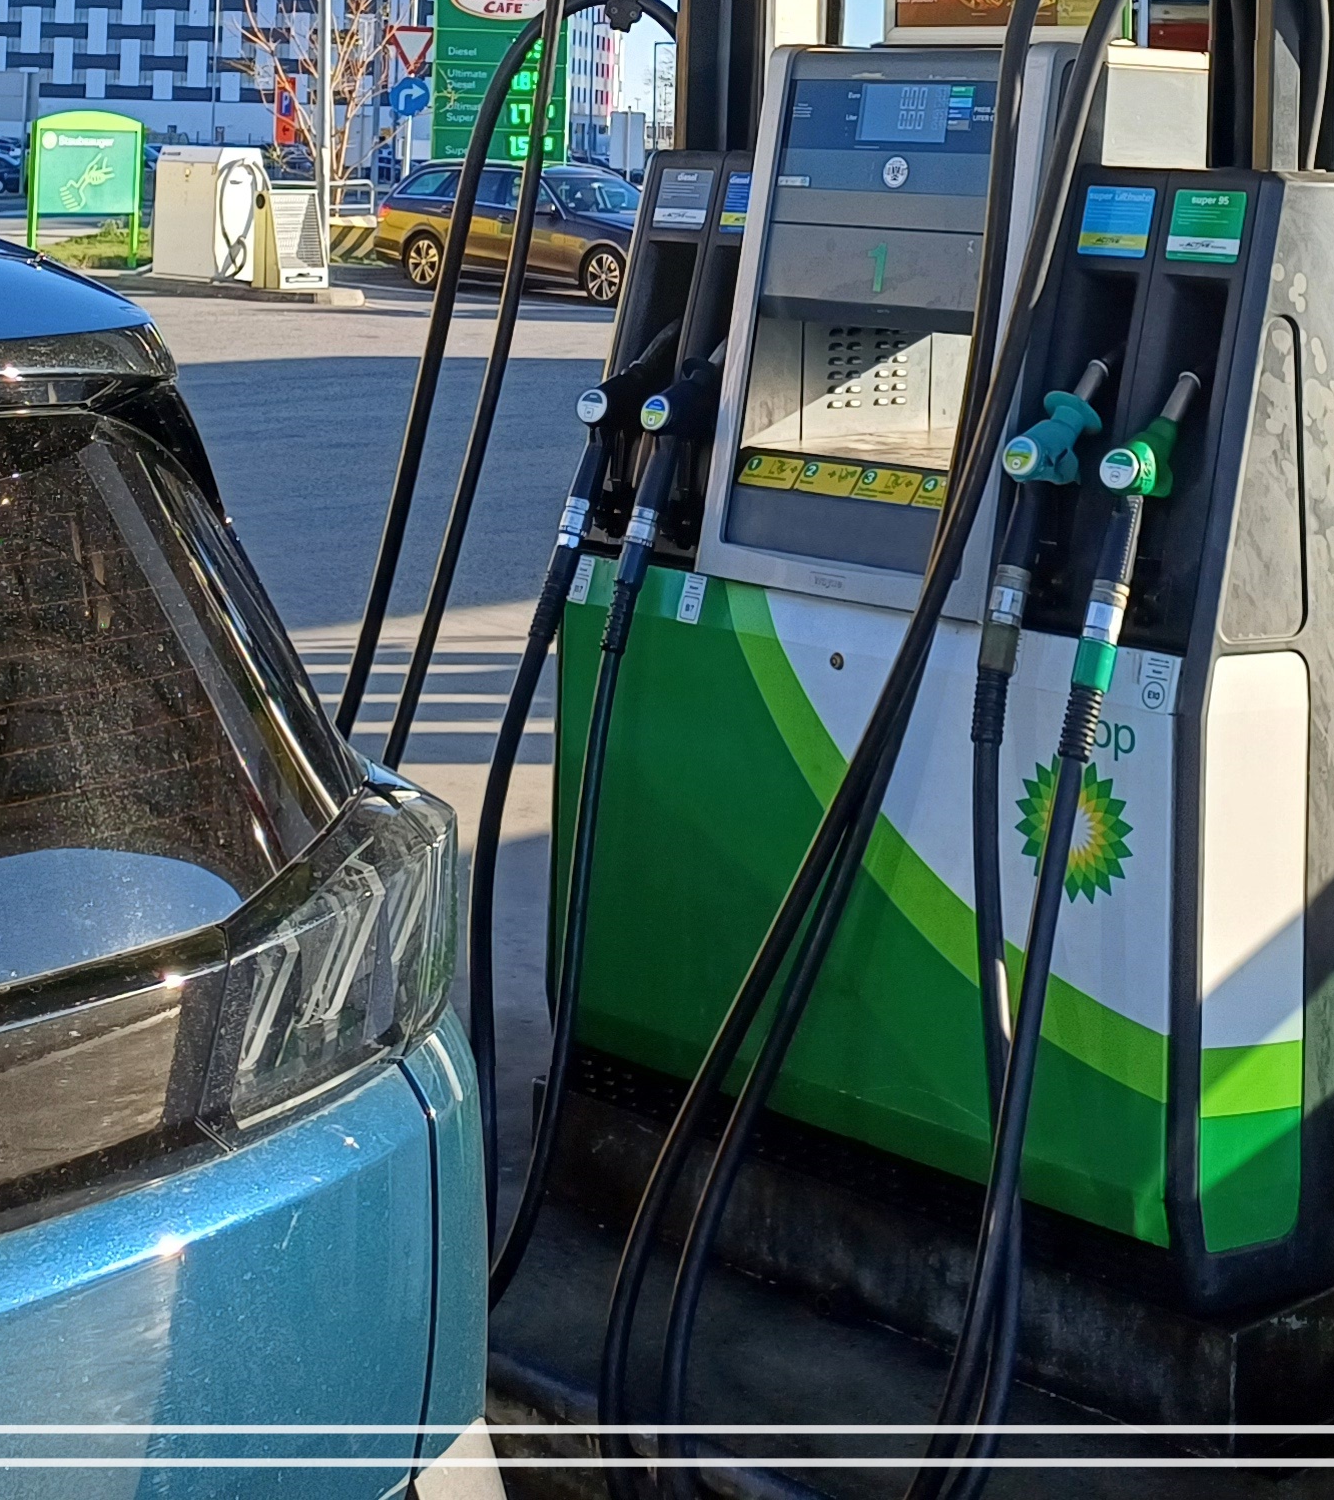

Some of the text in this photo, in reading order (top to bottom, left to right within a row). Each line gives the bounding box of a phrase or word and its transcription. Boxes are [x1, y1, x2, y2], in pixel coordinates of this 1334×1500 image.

[448, 46, 477, 57] Diesel
[447, 68, 487, 79] Ultimate
[281, 92, 290, 115] P
[446, 112, 474, 122] Super
[677, 172, 698, 182] diesel
[1191, 195, 1230, 205] super 95
[867, 242, 887, 293] 1
[751, 458, 759, 470] 1
[805, 465, 814, 476] 2
[864, 472, 875, 484] 3
[924, 479, 936, 490] 4
